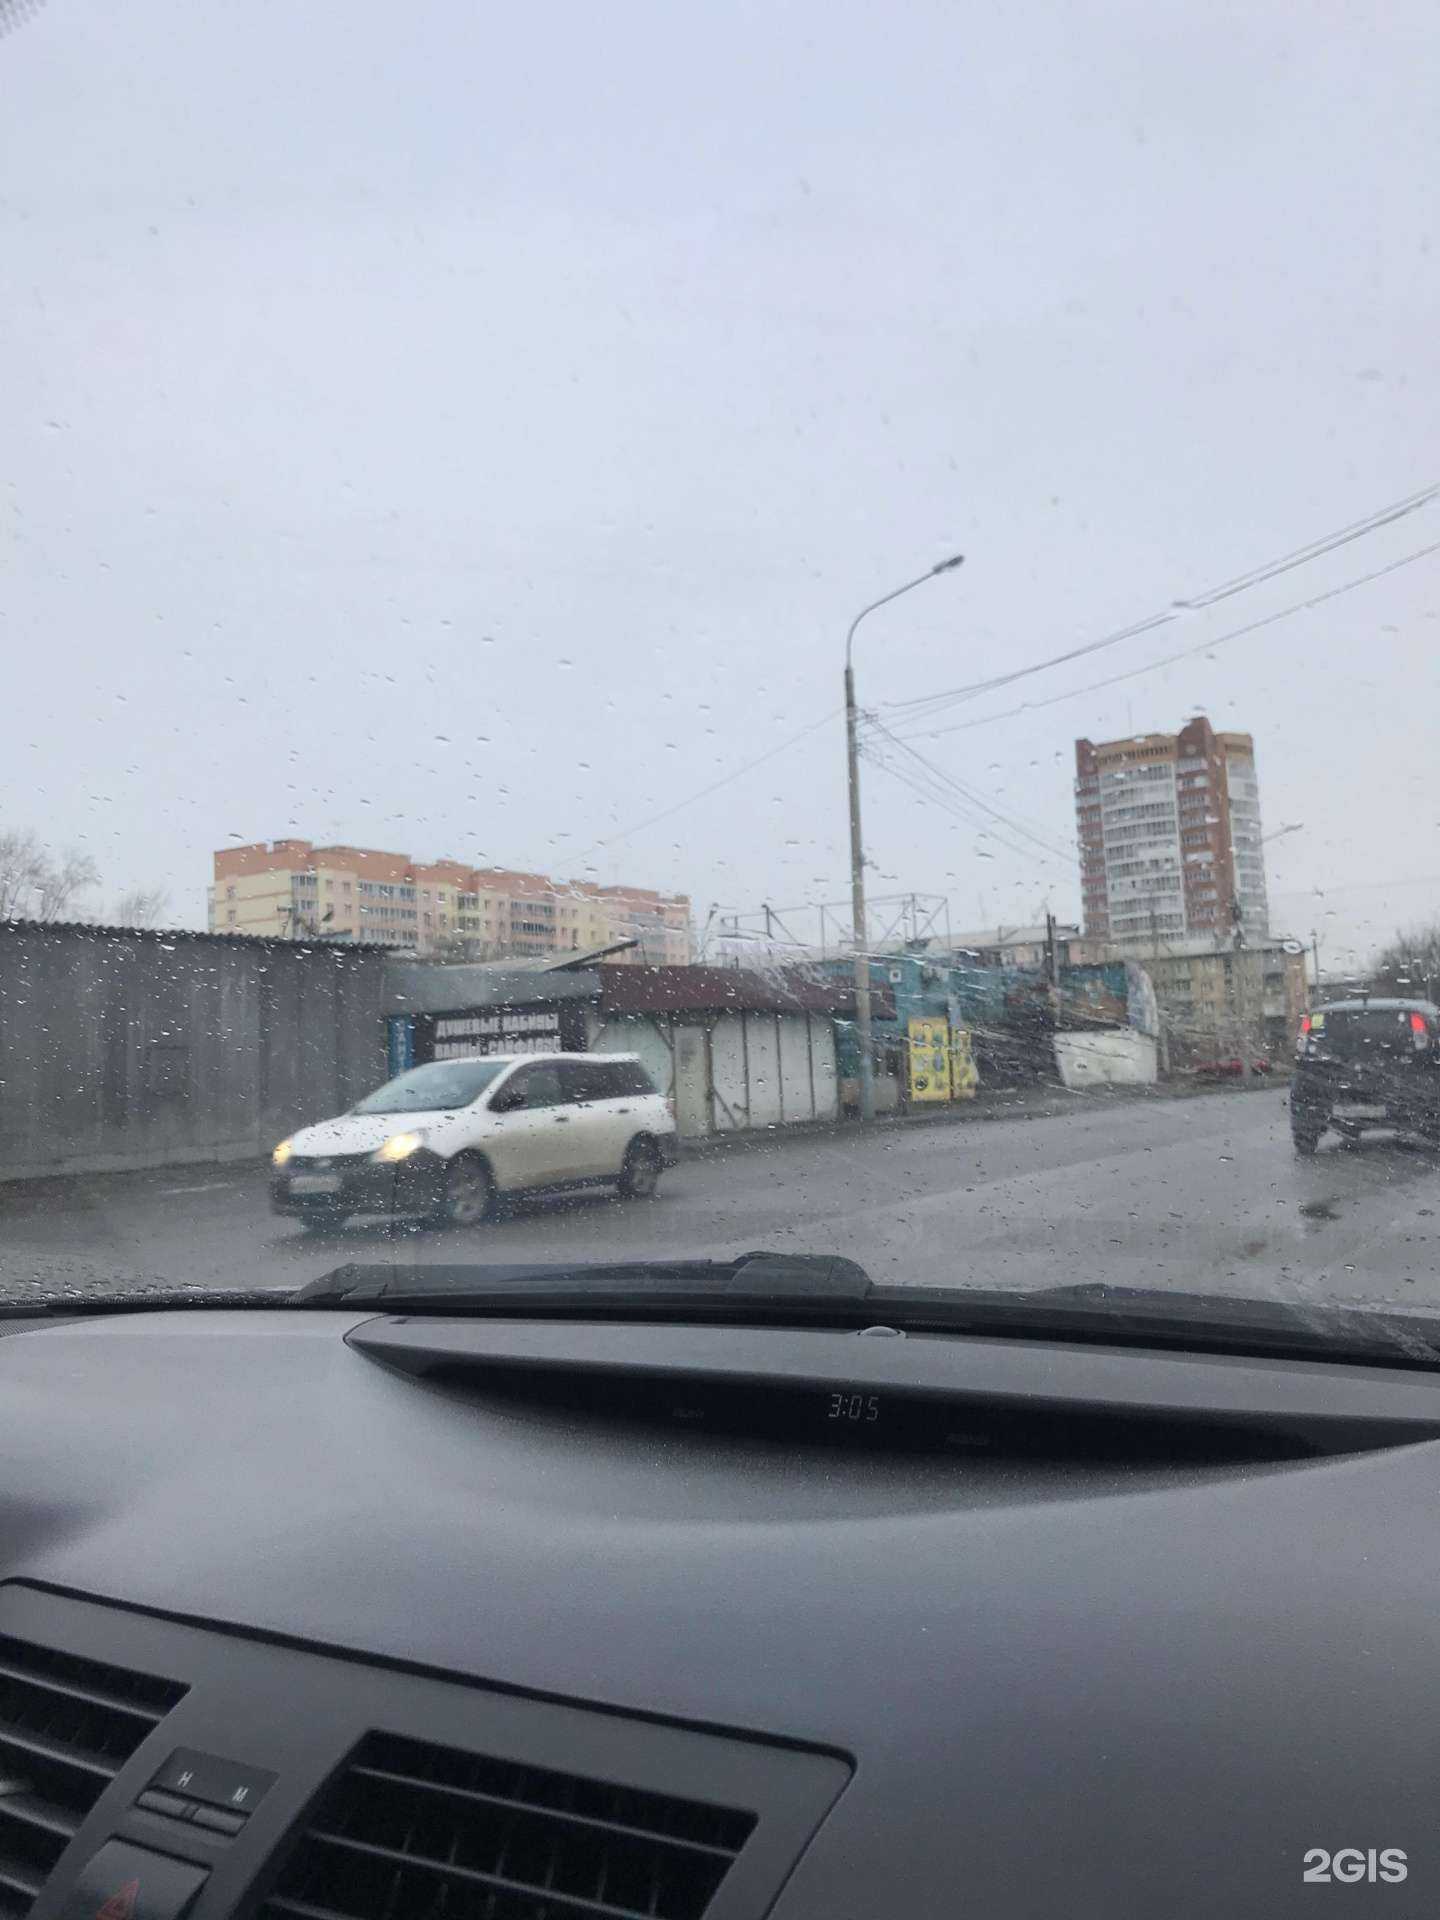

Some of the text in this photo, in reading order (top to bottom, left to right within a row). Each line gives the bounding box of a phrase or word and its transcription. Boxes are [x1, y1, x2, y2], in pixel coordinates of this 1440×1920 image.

[827, 1393, 880, 1421] 3:05
[177, 1770, 194, 1788] H
[231, 1785, 249, 1803] M
